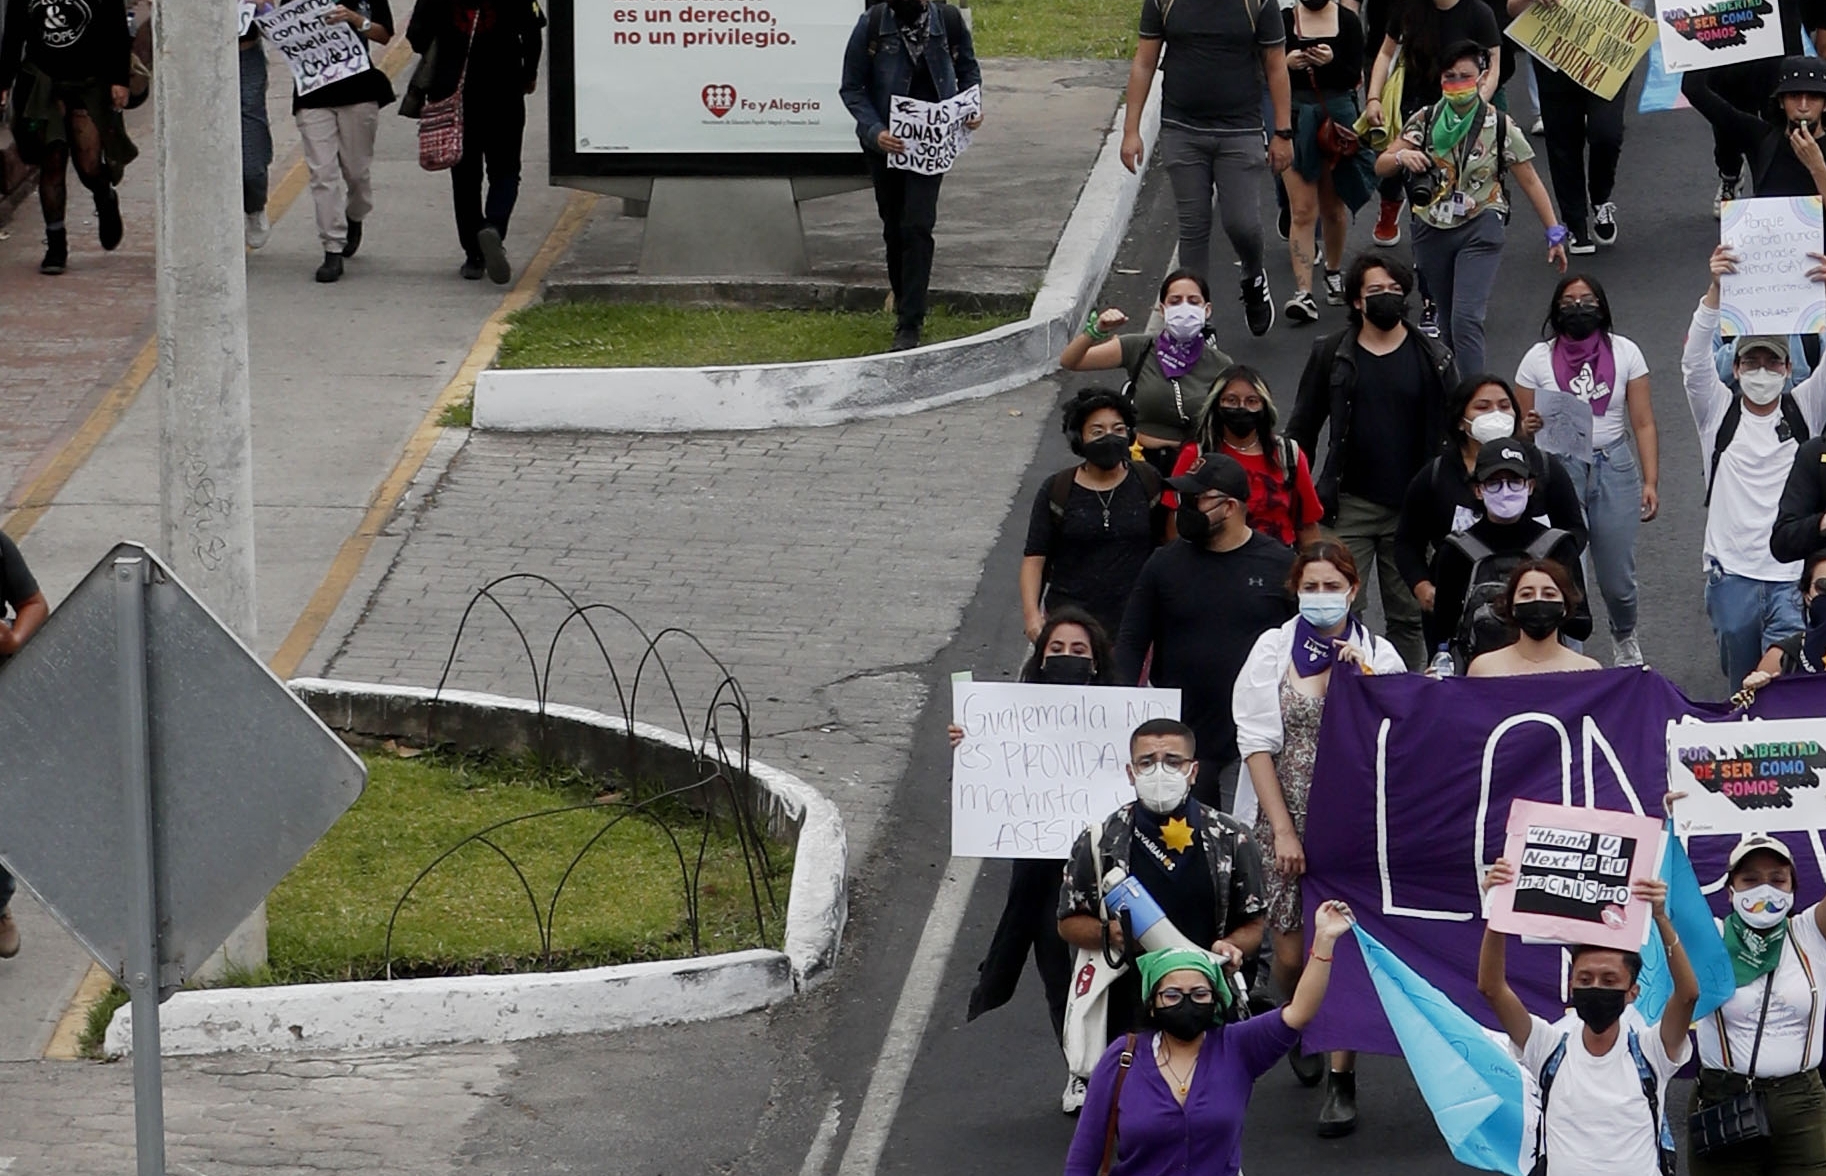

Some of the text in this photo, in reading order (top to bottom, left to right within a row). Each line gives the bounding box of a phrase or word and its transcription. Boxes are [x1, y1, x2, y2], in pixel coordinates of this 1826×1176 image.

[44, 5, 69, 29] &
[613, 5, 777, 27] es un derecho,
[1662, 8, 1685, 20] POR
[1694, 16, 1718, 30] SER
[1721, 10, 1754, 25] COMO
[43, 29, 77, 43] HOPE
[613, 27, 797, 49] no un privilegio.
[1696, 26, 1737, 41] SOMOS
[741, 97, 821, 113] Fe y Alegría
[927, 105, 951, 127] LAS
[891, 119, 942, 144] ZONAS
[963, 693, 1107, 739] Guatemala
[959, 740, 1121, 780] es PROVIDA
[1678, 741, 1819, 762] POR LA LIBERTAD
[1693, 759, 1806, 780] DE SER COMO
[1722, 779, 1779, 797] SOMOS
[1583, 857, 1597, 869] a
